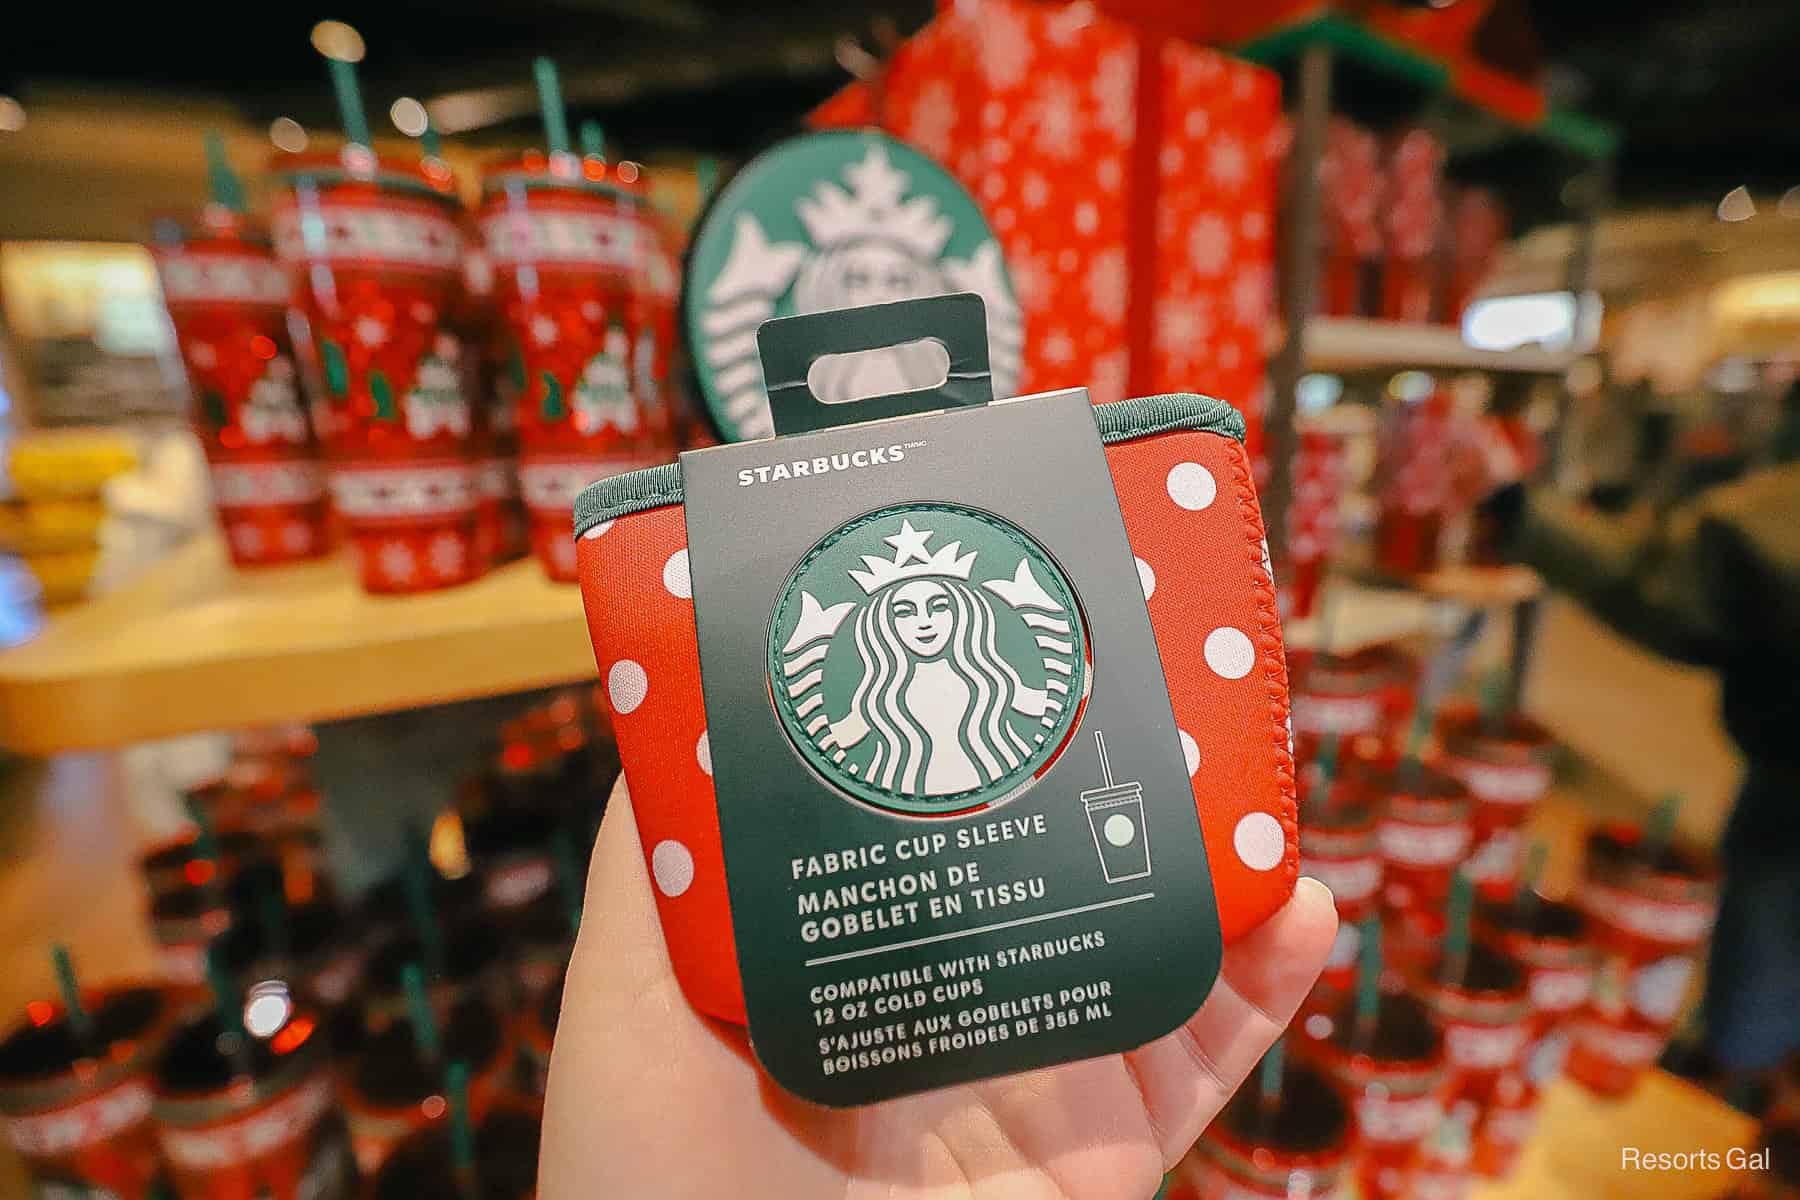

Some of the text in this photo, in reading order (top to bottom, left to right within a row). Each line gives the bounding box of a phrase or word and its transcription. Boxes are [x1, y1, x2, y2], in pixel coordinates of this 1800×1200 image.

[738, 444, 905, 486] STARBUCKS
[792, 814, 1047, 879] FABRIC CUP SLEEVE
[798, 863, 980, 915] MANCHON DE
[801, 878, 1045, 943] GOBELET EN TISSU
[810, 931, 1105, 1004] COMPATIBLE WITH STARBUCKS
[814, 979, 984, 1026] 12 OZ COLD CUPS
[819, 981, 1112, 1055] S'AJUSTE AUX GOBELETS POUR
[823, 1042, 922, 1075] BOISSONS
[929, 1023, 1009, 1054] FROIDES
[1016, 1017, 1039, 1035] DE
[1086, 1002, 1112, 1020] ML
